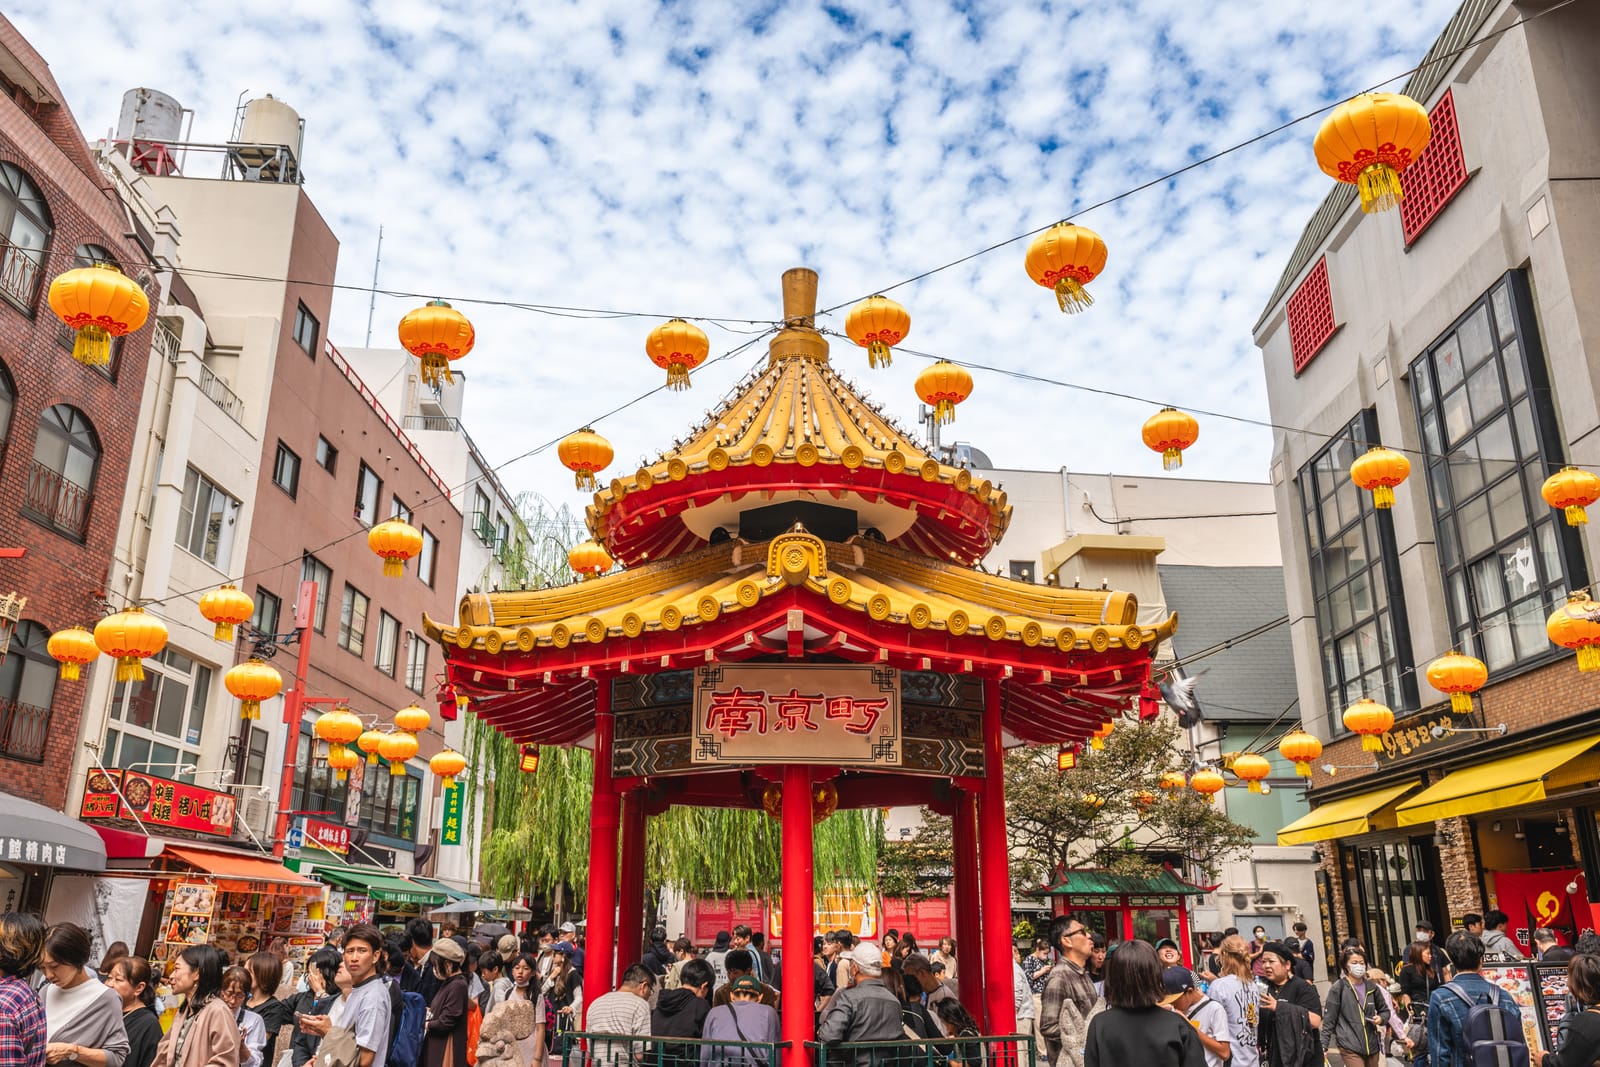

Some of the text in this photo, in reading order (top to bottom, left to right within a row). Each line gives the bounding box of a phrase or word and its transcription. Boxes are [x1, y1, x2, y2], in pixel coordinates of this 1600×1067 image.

[706, 687, 888, 736] 南京町
[155, 783, 174, 801] 中華
[151, 801, 171, 820] 料理
